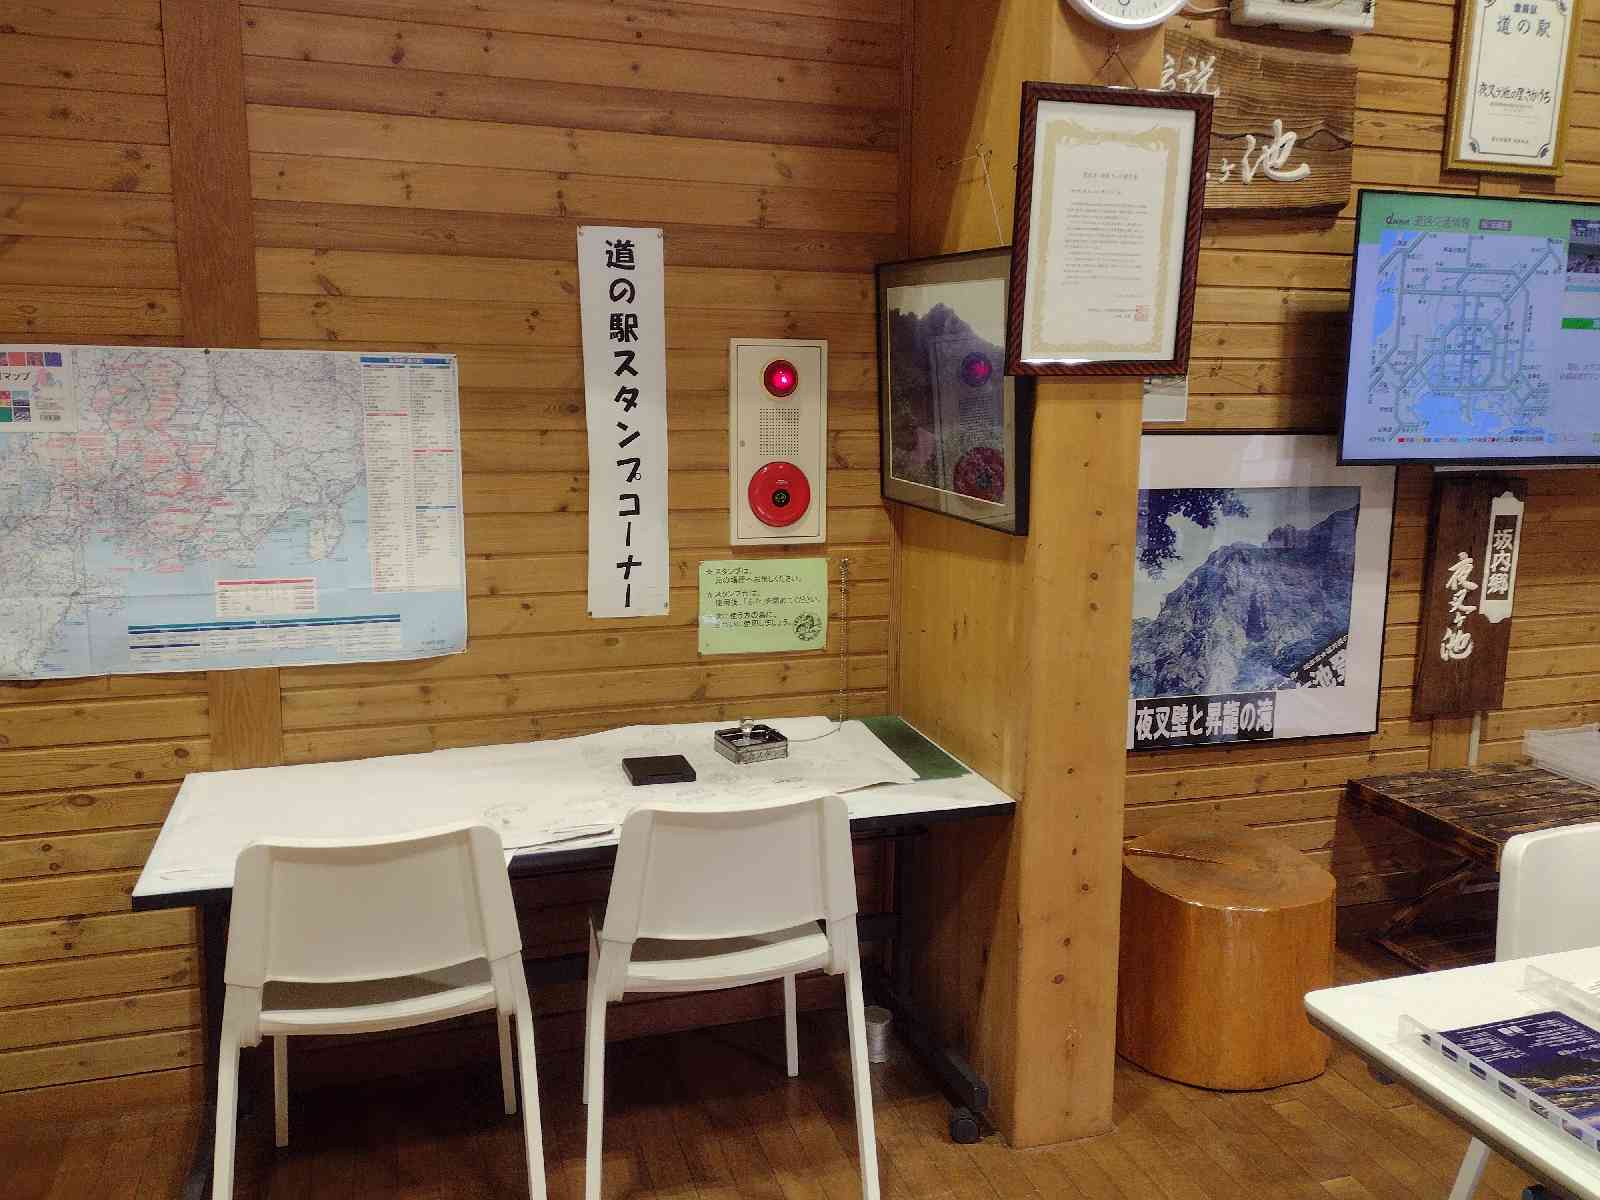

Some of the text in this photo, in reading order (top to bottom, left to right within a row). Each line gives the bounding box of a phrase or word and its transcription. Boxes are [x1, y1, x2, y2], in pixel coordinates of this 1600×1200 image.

[1496, 16, 1552, 38] 道の駅
[605, 239, 642, 608] 道の駅スタンプコーナー
